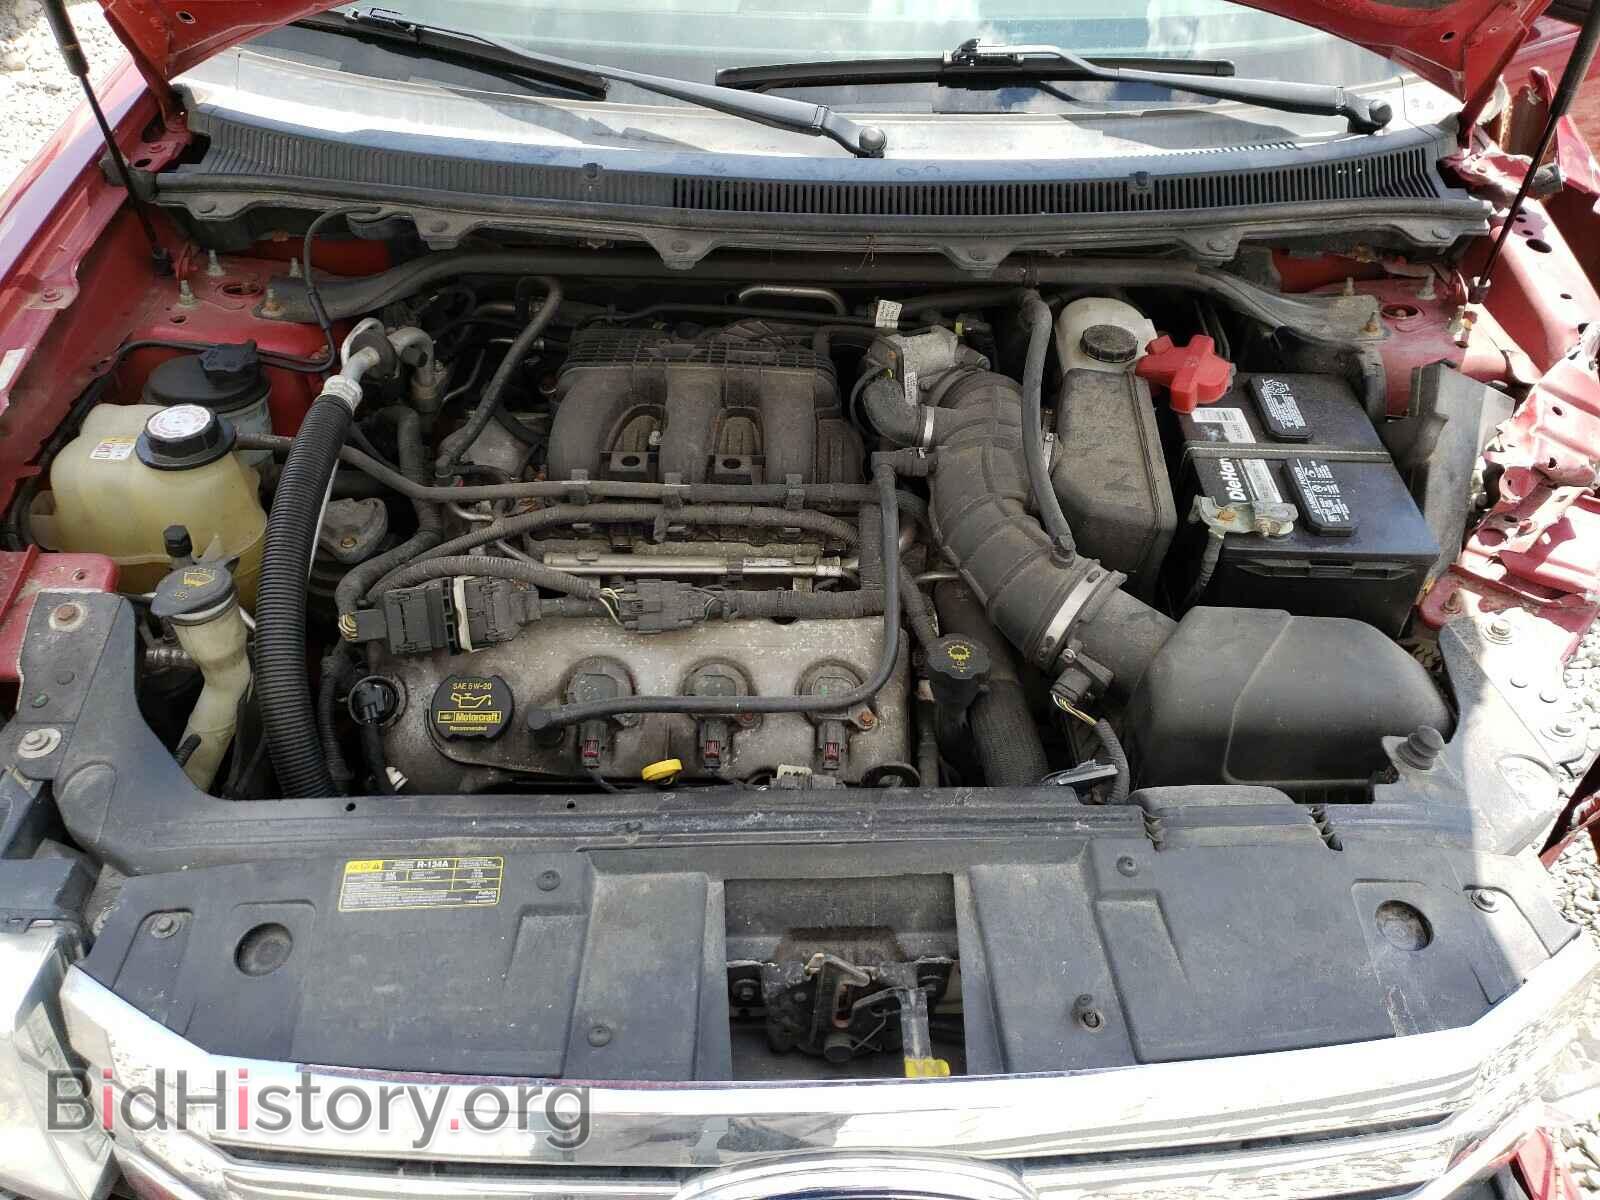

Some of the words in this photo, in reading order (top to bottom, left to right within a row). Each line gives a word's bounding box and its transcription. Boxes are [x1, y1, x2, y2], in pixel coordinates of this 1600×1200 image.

[1220, 458, 1247, 501] DieHar
[452, 682, 467, 690] SAE
[456, 712, 498, 722] Motorcraft
[416, 860, 449, 868] R-134A
